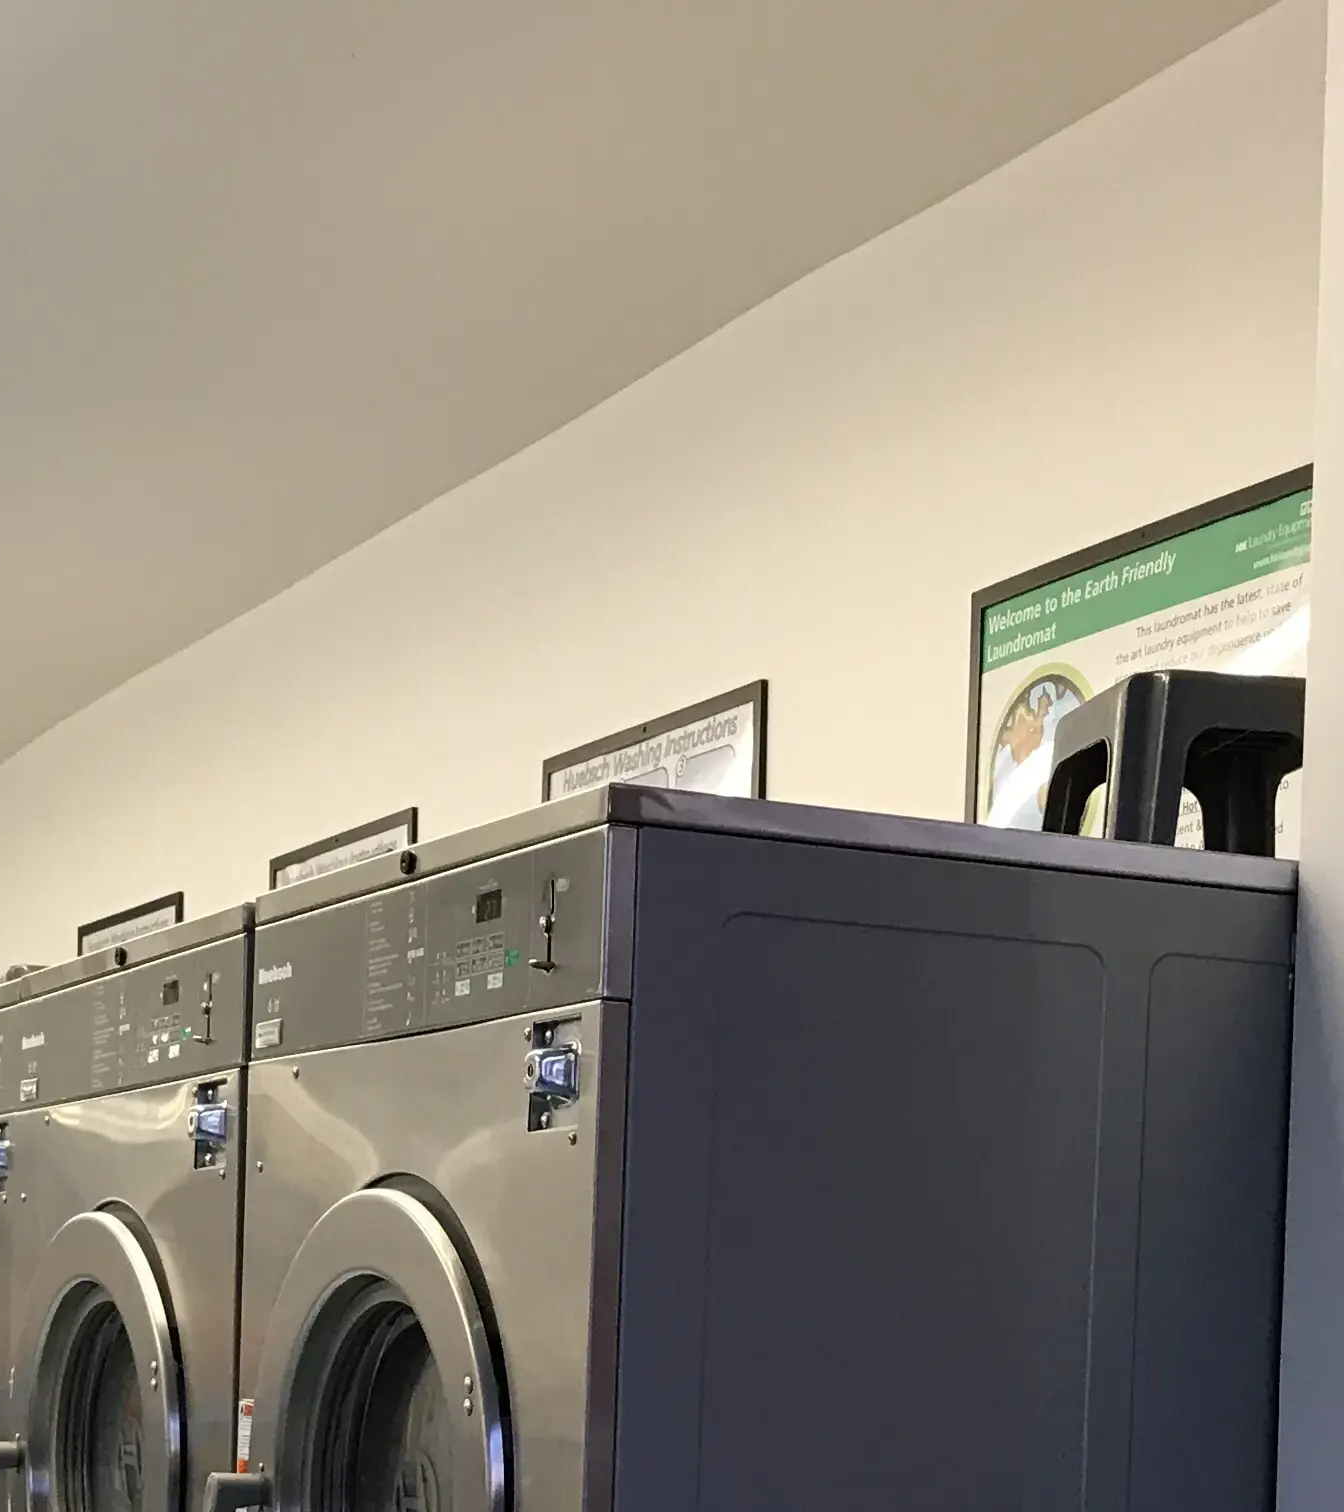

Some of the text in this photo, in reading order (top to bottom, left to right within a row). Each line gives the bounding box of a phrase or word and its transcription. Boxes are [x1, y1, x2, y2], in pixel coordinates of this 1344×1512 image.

[988, 550, 1176, 635] Welcome to the Earth Friendly
[1136, 626, 1152, 639] This
[1153, 608, 1201, 633] laundromat
[1203, 604, 1218, 617] has
[1220, 595, 1235, 611] the
[1266, 580, 1290, 597] state
[1292, 573, 1304, 588] of
[987, 623, 1057, 663] Laundromat
[1116, 601, 1292, 666] the art laundry equipment to help to save
[562, 714, 738, 793] Huebsch Washing Instructions
